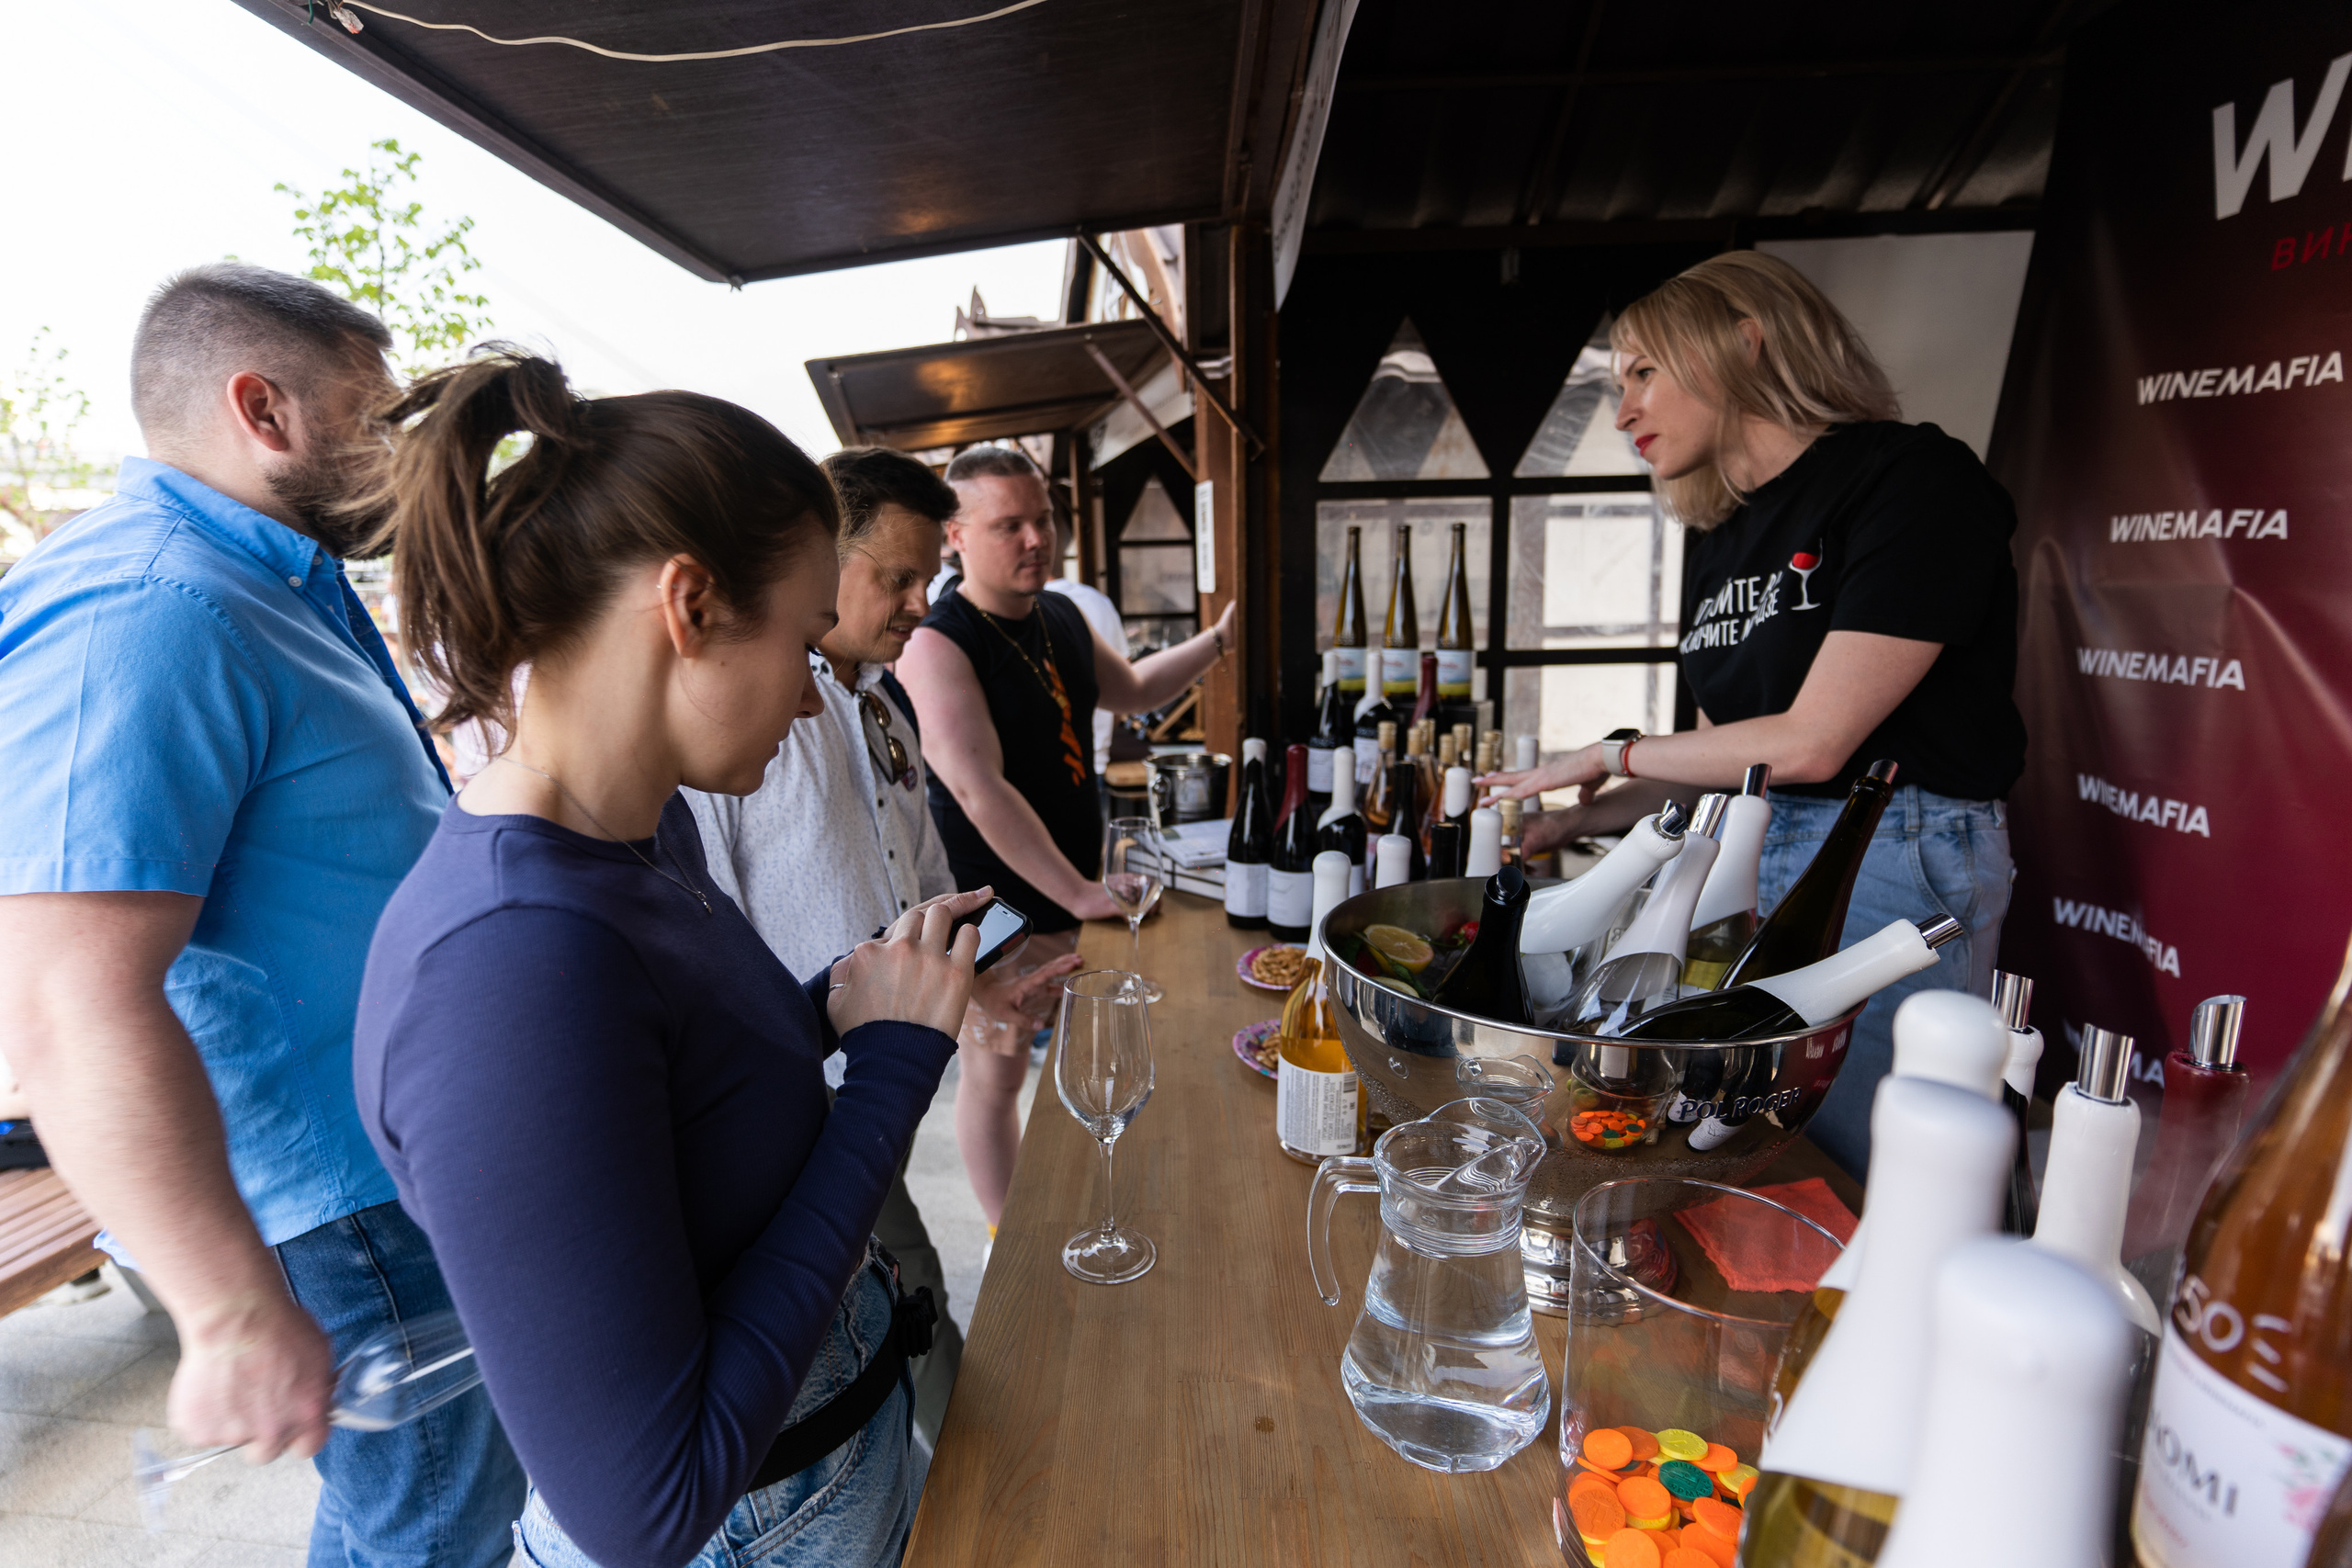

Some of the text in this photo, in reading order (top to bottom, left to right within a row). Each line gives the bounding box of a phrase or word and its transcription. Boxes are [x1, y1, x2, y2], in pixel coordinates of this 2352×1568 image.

[2212, 51, 2352, 220] W
[2136, 351, 2344, 406] WINEMAFIA
[2109, 509, 2289, 542] WINEMAFIA
[2076, 647, 2246, 691] WINEMAFIA
[1679, 1087, 1802, 1121] POL ROGER
